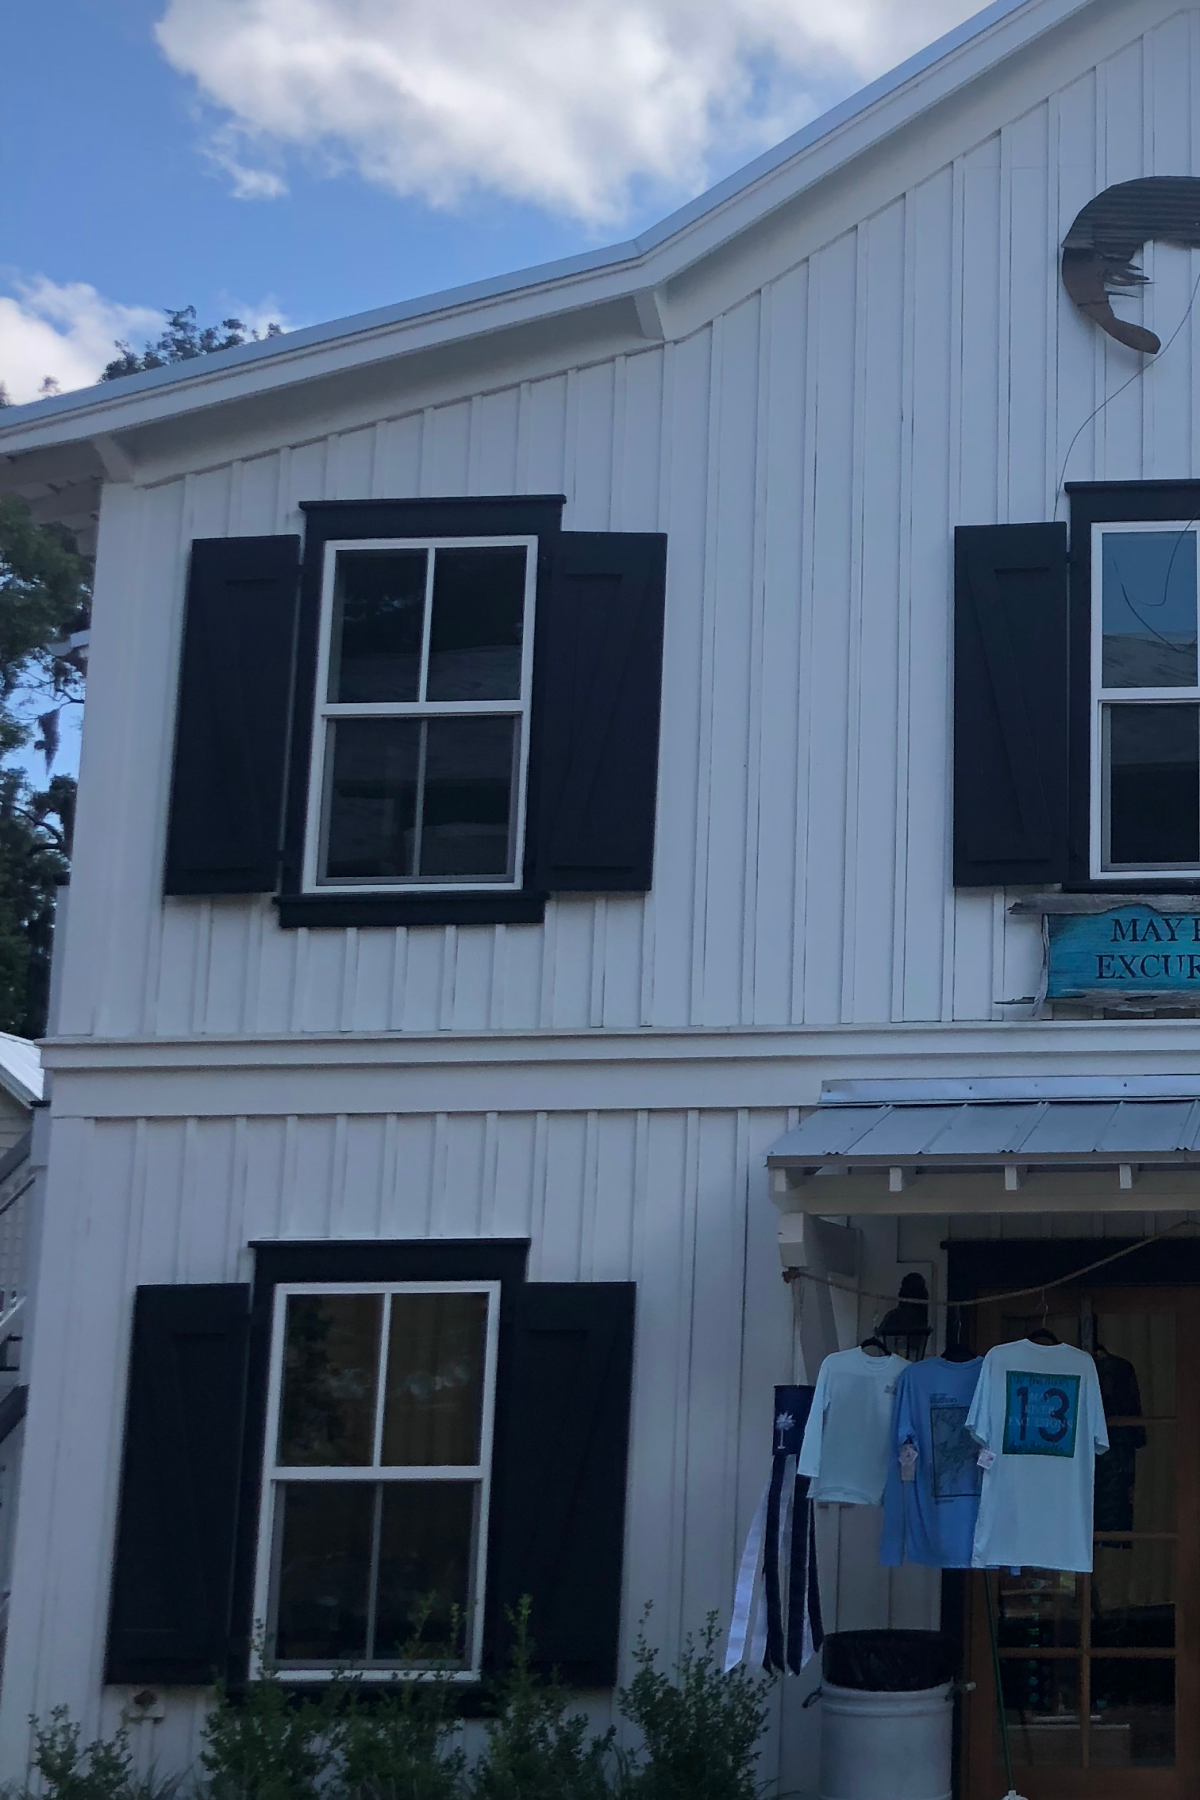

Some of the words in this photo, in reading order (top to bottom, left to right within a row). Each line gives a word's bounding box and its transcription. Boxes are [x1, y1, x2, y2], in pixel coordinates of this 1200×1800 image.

[1110, 918, 1183, 942] MAY
[1016, 1386, 1070, 1442] 13
[1024, 1404, 1056, 1415] RIVER
